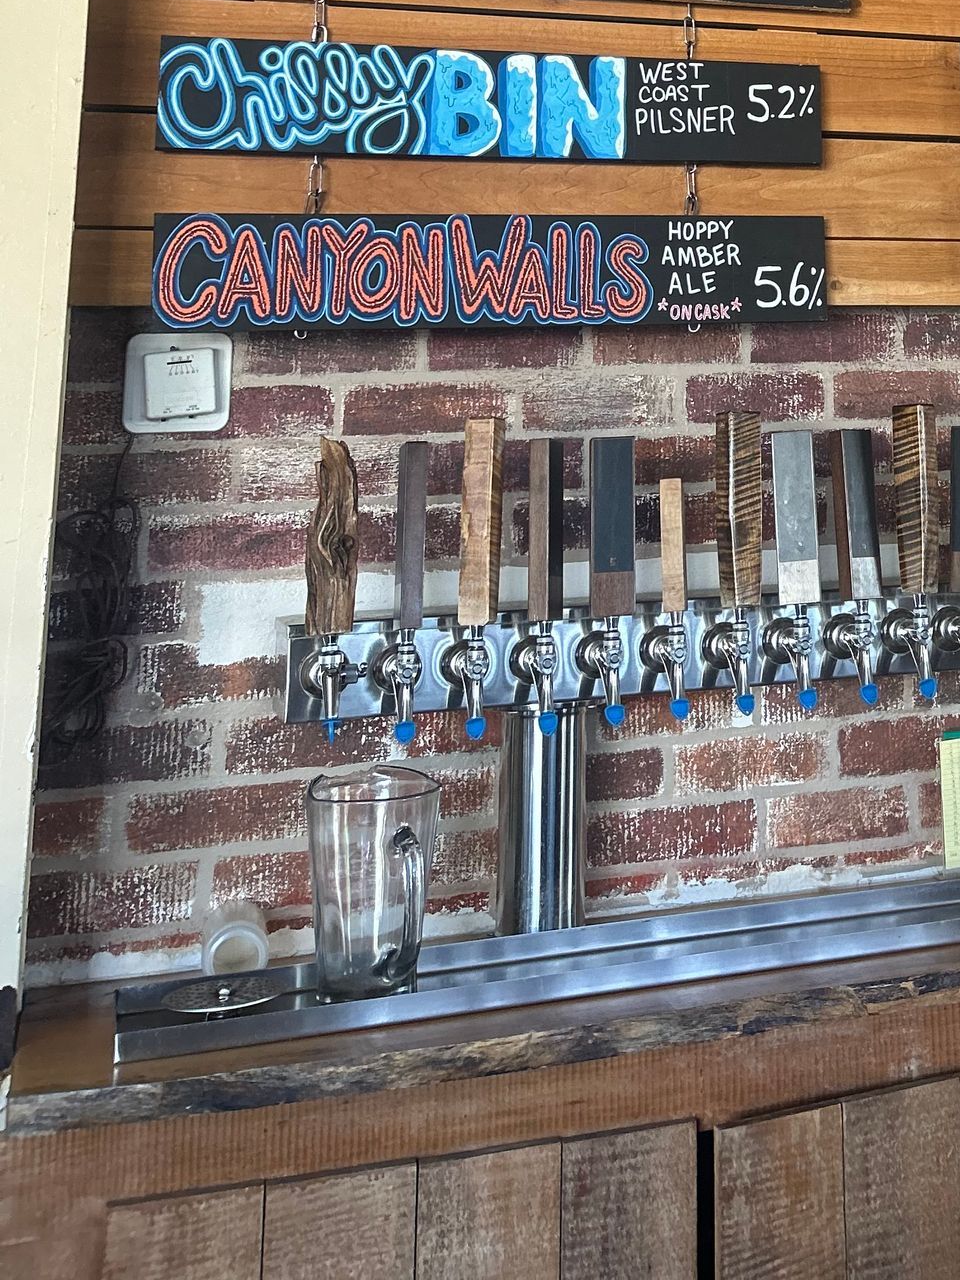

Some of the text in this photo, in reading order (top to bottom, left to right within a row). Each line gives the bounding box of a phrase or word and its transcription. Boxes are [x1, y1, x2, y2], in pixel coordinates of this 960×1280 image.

[638, 61, 704, 84] WEST
[157, 37, 626, 159] Chilly BIN
[638, 84, 710, 104] COAST
[747, 83, 815, 122] 5.2%
[635, 104, 736, 136] PILSNER
[668, 220, 734, 241] HOPPY
[661, 243, 742, 268] AMBER
[668, 271, 717, 295] ALE
[754, 261, 825, 310] 5.6%
